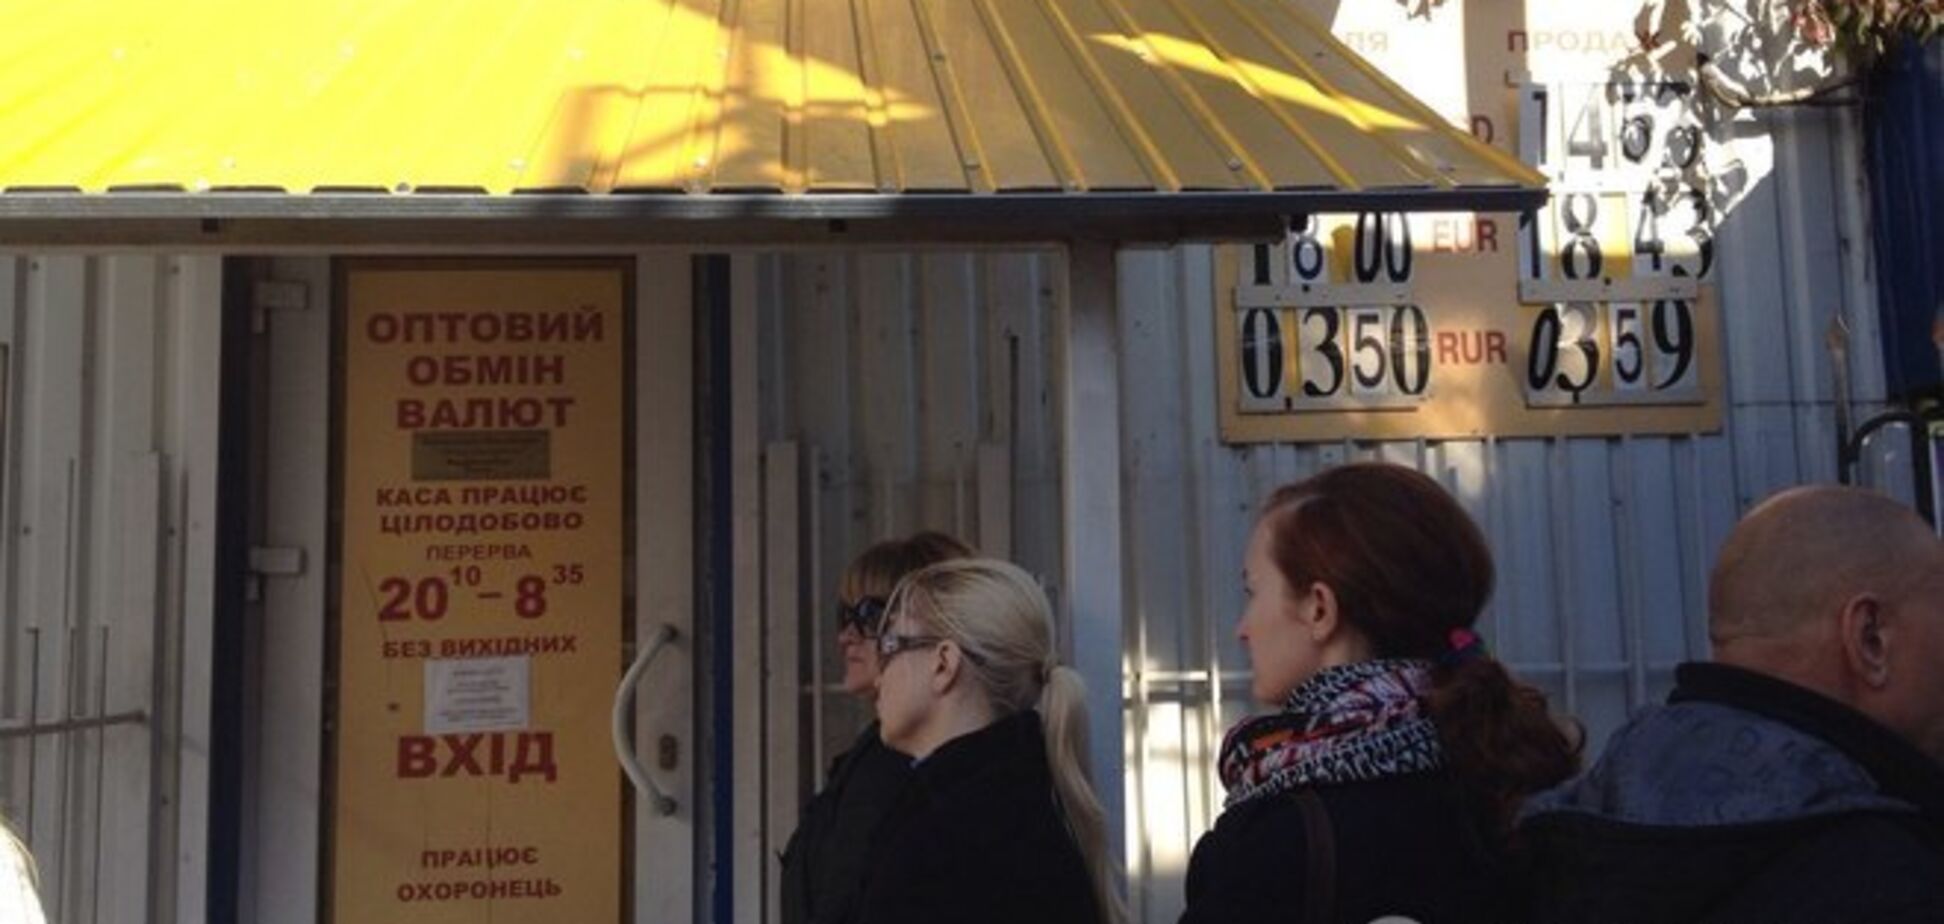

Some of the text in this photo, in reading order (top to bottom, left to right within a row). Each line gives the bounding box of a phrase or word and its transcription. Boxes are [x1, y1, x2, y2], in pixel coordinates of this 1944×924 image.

[1433, 220, 1498, 252] EUR
[366, 305, 605, 344] ОПТОВИЙ
[1437, 330, 1508, 365] RUR
[406, 355, 564, 387] ОБМІН
[396, 397, 576, 430] ВАЛЮТ
[376, 485, 588, 507] КАСА ПРАЦЮЄ
[380, 511, 584, 535] ЦІЛОДОБОВО
[425, 544, 533, 561] ПЕРЕРВА
[383, 635, 578, 659] БЕЗ ВИХІДНИХ
[396, 732, 558, 783] ВХІД
[421, 847, 540, 869] ПРАЦЮЄ
[397, 879, 563, 902] ОХОРОНЕЦЬ
